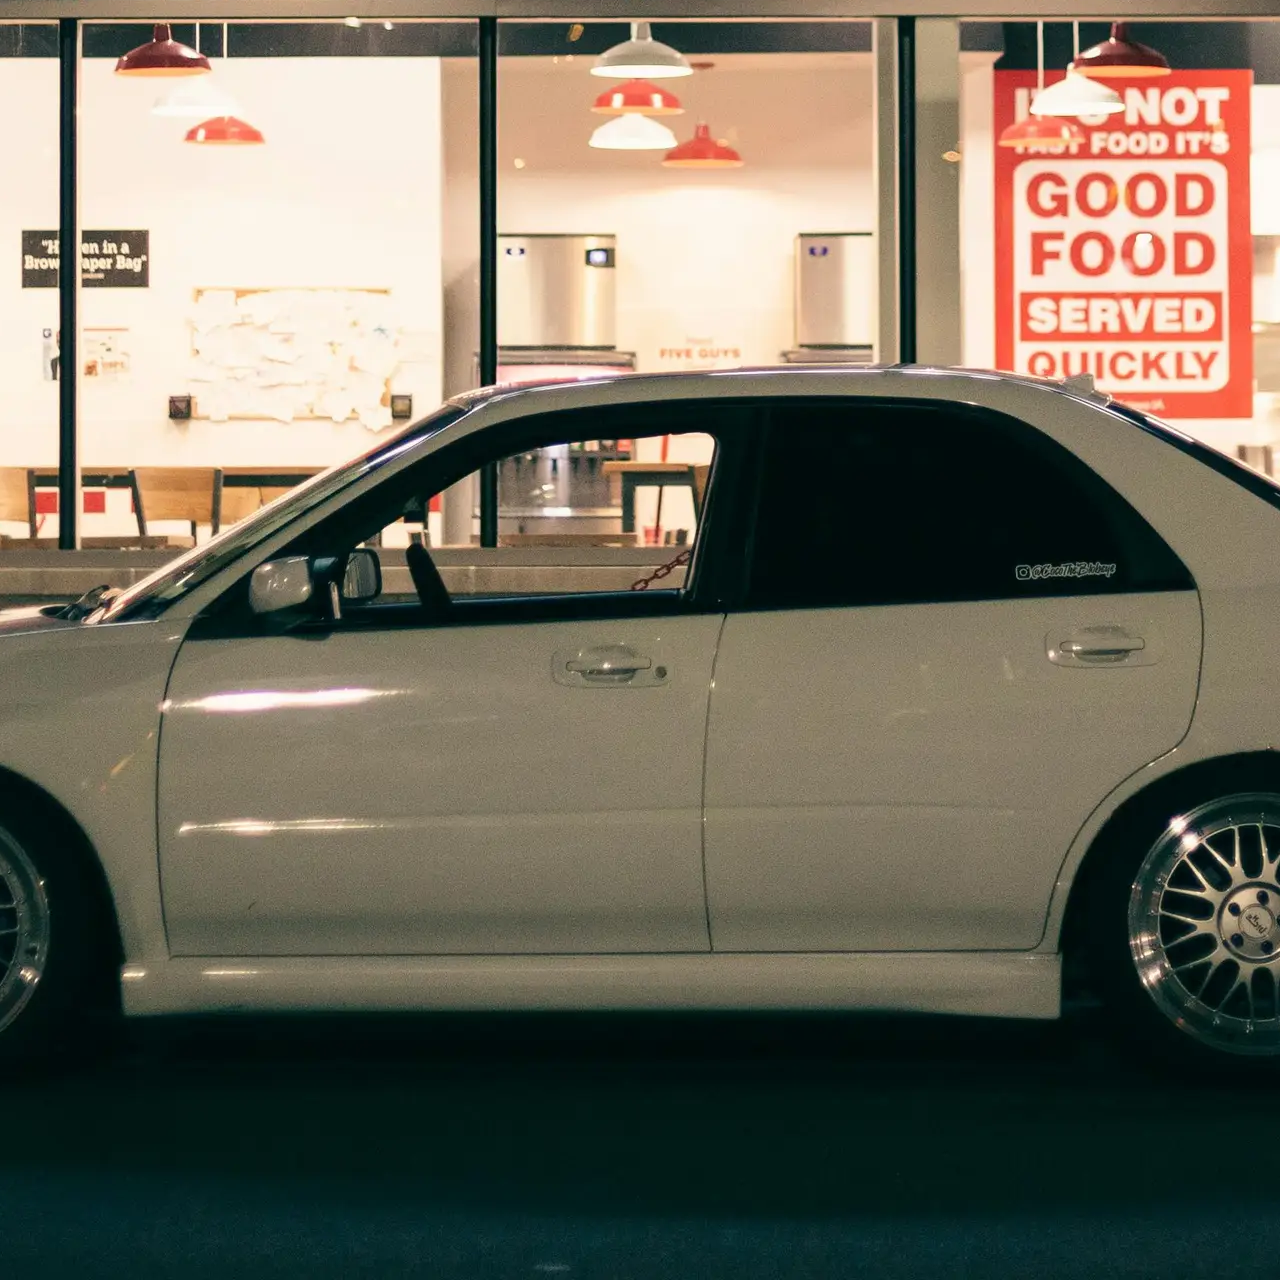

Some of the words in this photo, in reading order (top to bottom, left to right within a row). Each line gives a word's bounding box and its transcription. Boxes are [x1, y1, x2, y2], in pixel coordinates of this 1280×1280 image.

[1124, 87, 1230, 126] NOT
[1090, 131, 1170, 155] FOOD
[1175, 131, 1230, 155] IT'S
[1026, 172, 1215, 218] GOOD
[103, 239, 118, 254] in
[121, 242, 130, 254] a
[1030, 231, 1216, 277] FOOD
[24, 255, 60, 269] Brow
[81, 257, 113, 272] aper
[1026, 297, 1217, 335] SERVED
[1027, 351, 1219, 380] QUICKLY
